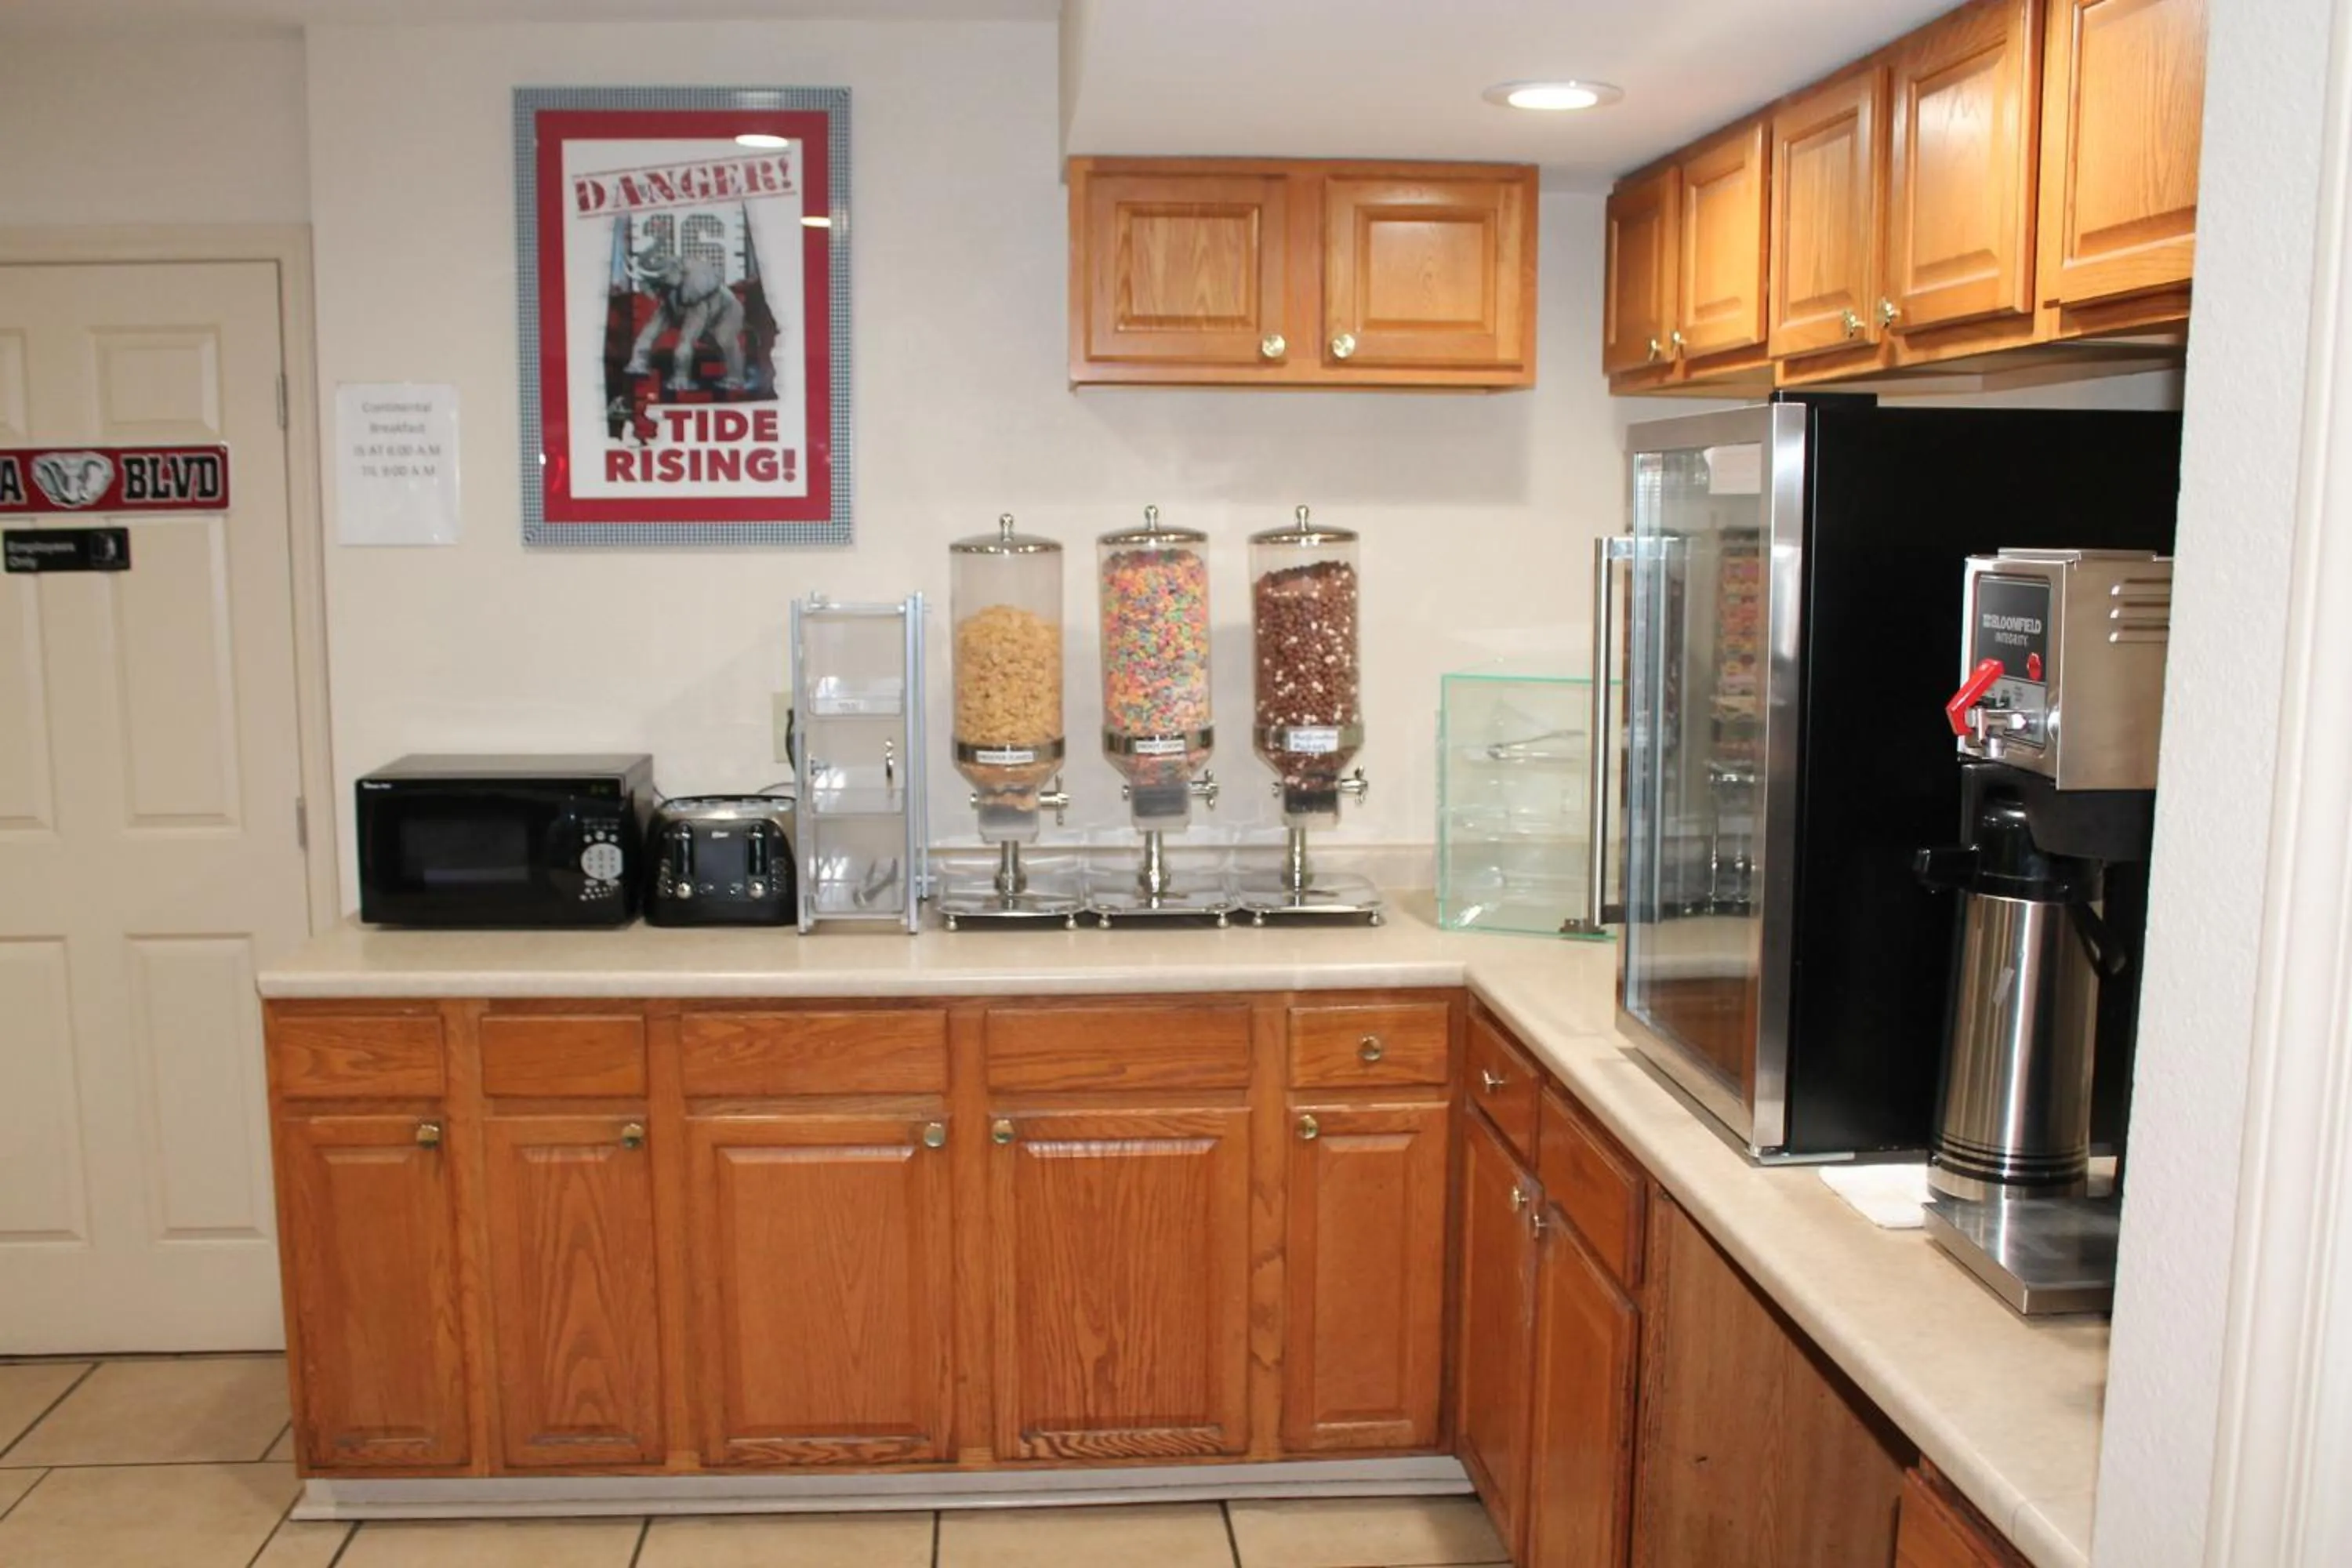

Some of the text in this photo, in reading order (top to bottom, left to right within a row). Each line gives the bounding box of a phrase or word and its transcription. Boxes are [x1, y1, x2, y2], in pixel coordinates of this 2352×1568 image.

[575, 157, 793, 212] DANGER!
[361, 401, 433, 413] Continental
[368, 421, 426, 434] Breakfast
[663, 408, 779, 442] TIDE
[368, 444, 383, 456] AT
[605, 448, 797, 483] RISING!
[122, 455, 220, 501] BLVD
[8, 555, 38, 570] Only
[1991, 615, 2042, 634] BLOOMFIELD
